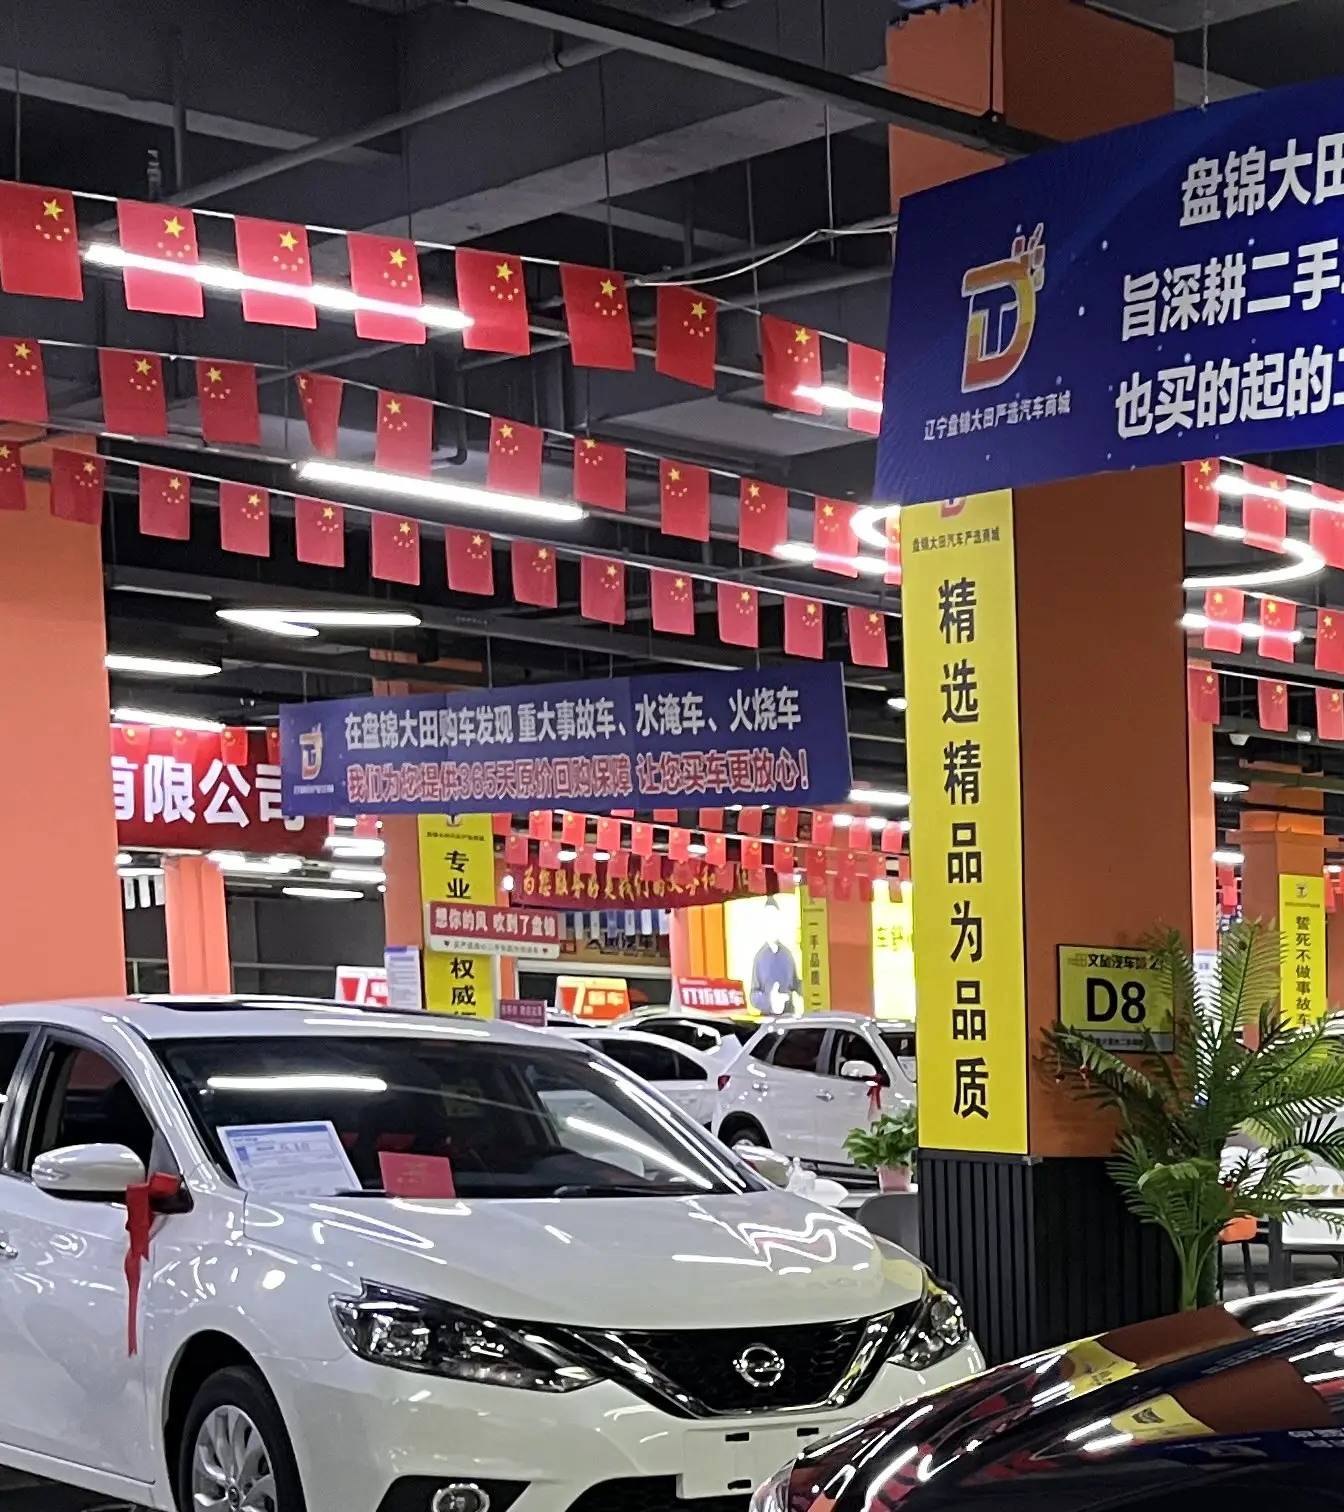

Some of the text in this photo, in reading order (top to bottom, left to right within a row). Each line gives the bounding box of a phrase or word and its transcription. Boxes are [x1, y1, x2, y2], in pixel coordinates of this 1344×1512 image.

[344, 704, 513, 751] 在盘锦大田购车发现
[728, 685, 801, 733] 火烧车
[937, 577, 990, 1120] 精选精品为品质
[1086, 977, 1147, 1024] D8
